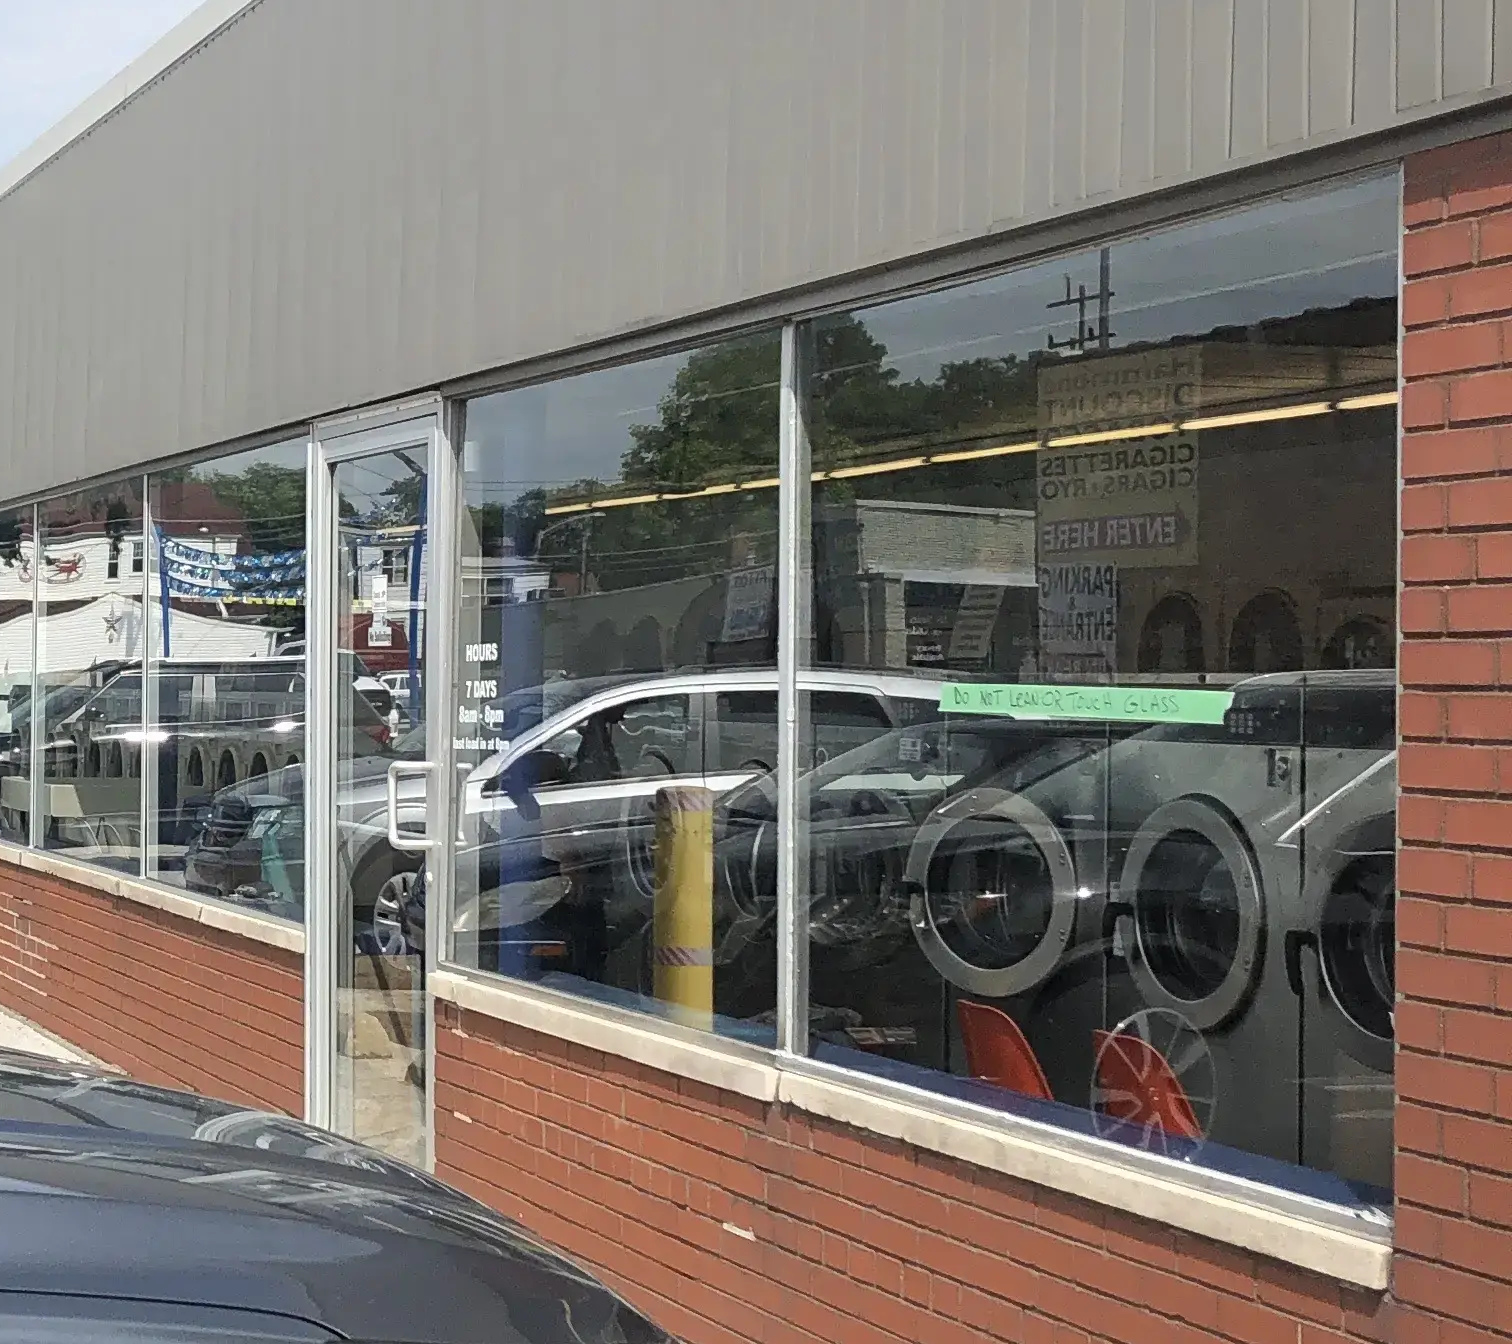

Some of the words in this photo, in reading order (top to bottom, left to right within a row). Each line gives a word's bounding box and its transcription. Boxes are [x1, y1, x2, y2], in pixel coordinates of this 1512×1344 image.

[465, 642, 498, 662] HOURS
[465, 681, 472, 698] 7
[473, 680, 498, 698] DAYS
[458, 705, 477, 723] 8am
[480, 736, 487, 750] in
